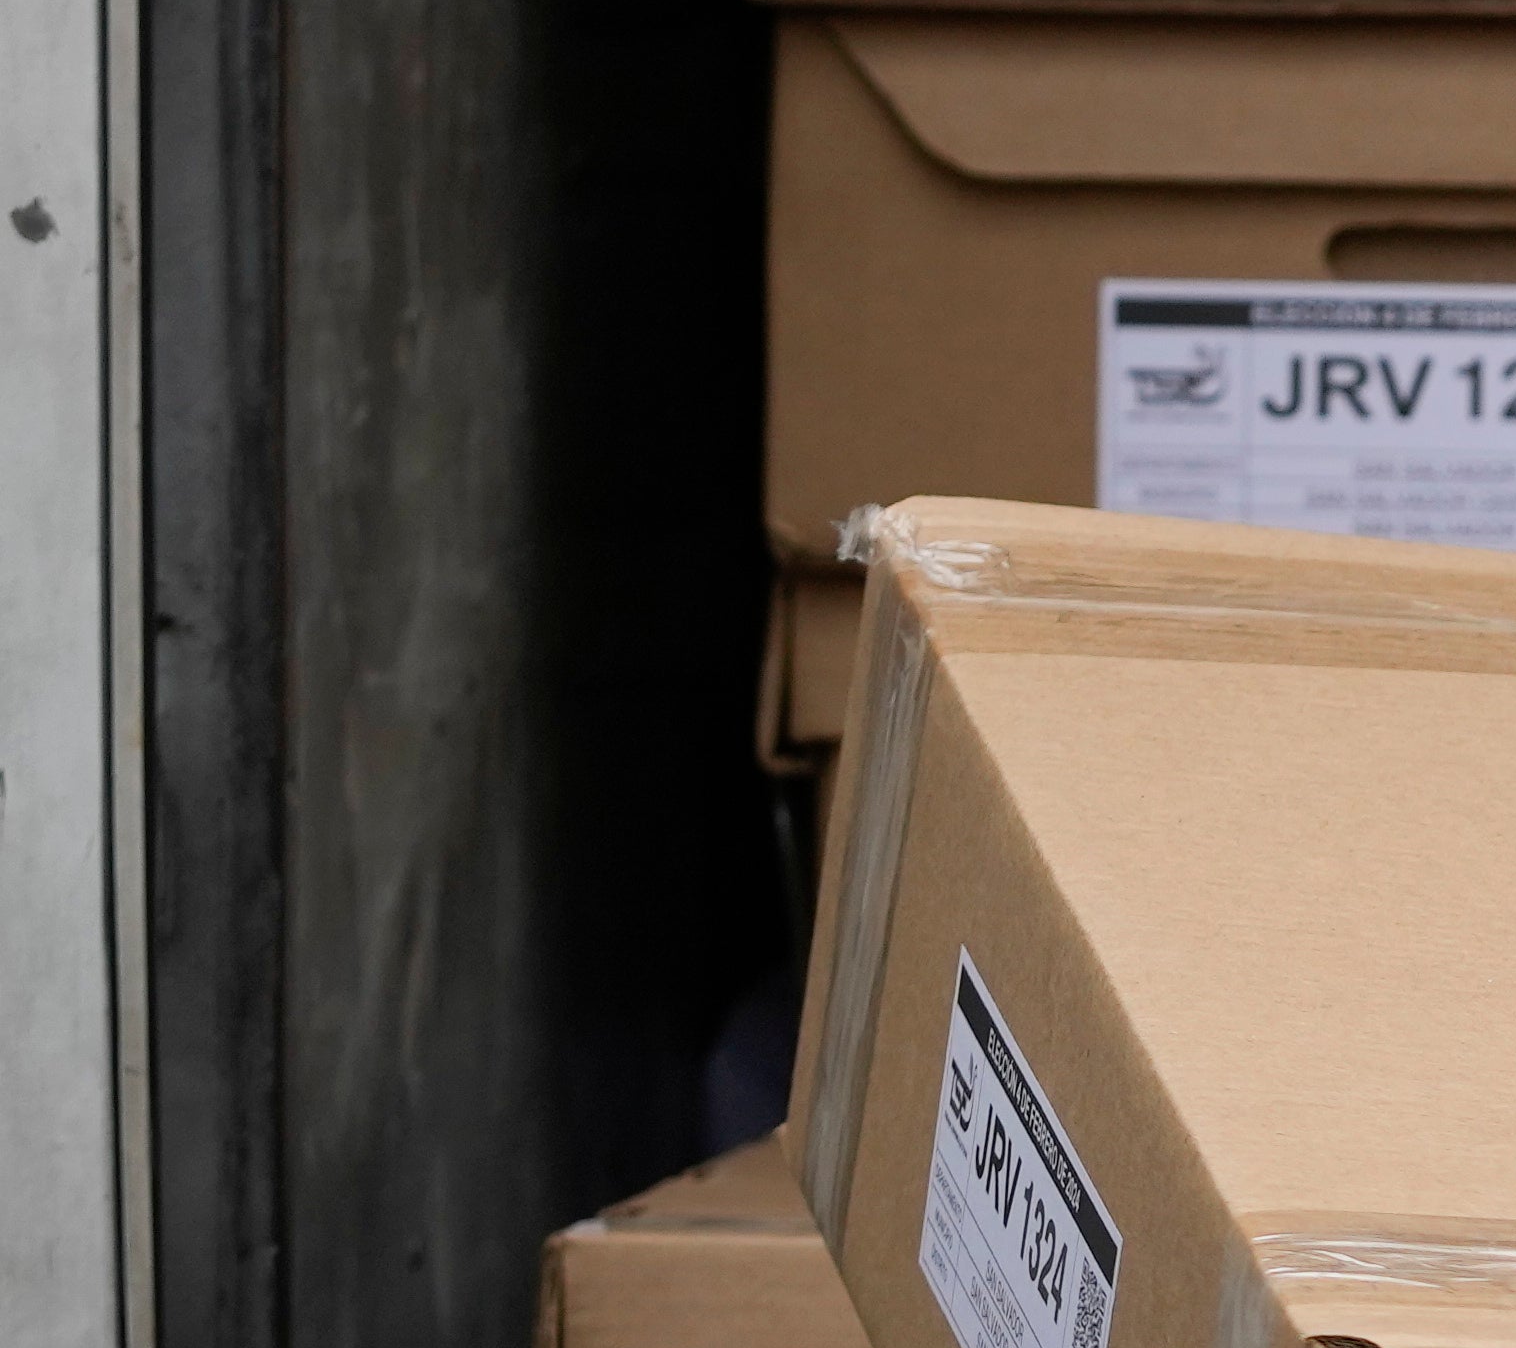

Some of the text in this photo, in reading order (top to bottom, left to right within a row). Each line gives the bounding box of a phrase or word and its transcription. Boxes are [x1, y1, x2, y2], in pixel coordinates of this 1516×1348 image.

[1261, 354, 1433, 421] JRV
[987, 1027, 1018, 1097] ELECCIÓN
[1020, 1085, 1032, 1120] DE
[1028, 1106, 1058, 1170] FEBRERO
[1056, 1156, 1068, 1188] DE
[1065, 1170, 1082, 1214] 2024
[975, 1102, 1070, 1327] JRV 1324
